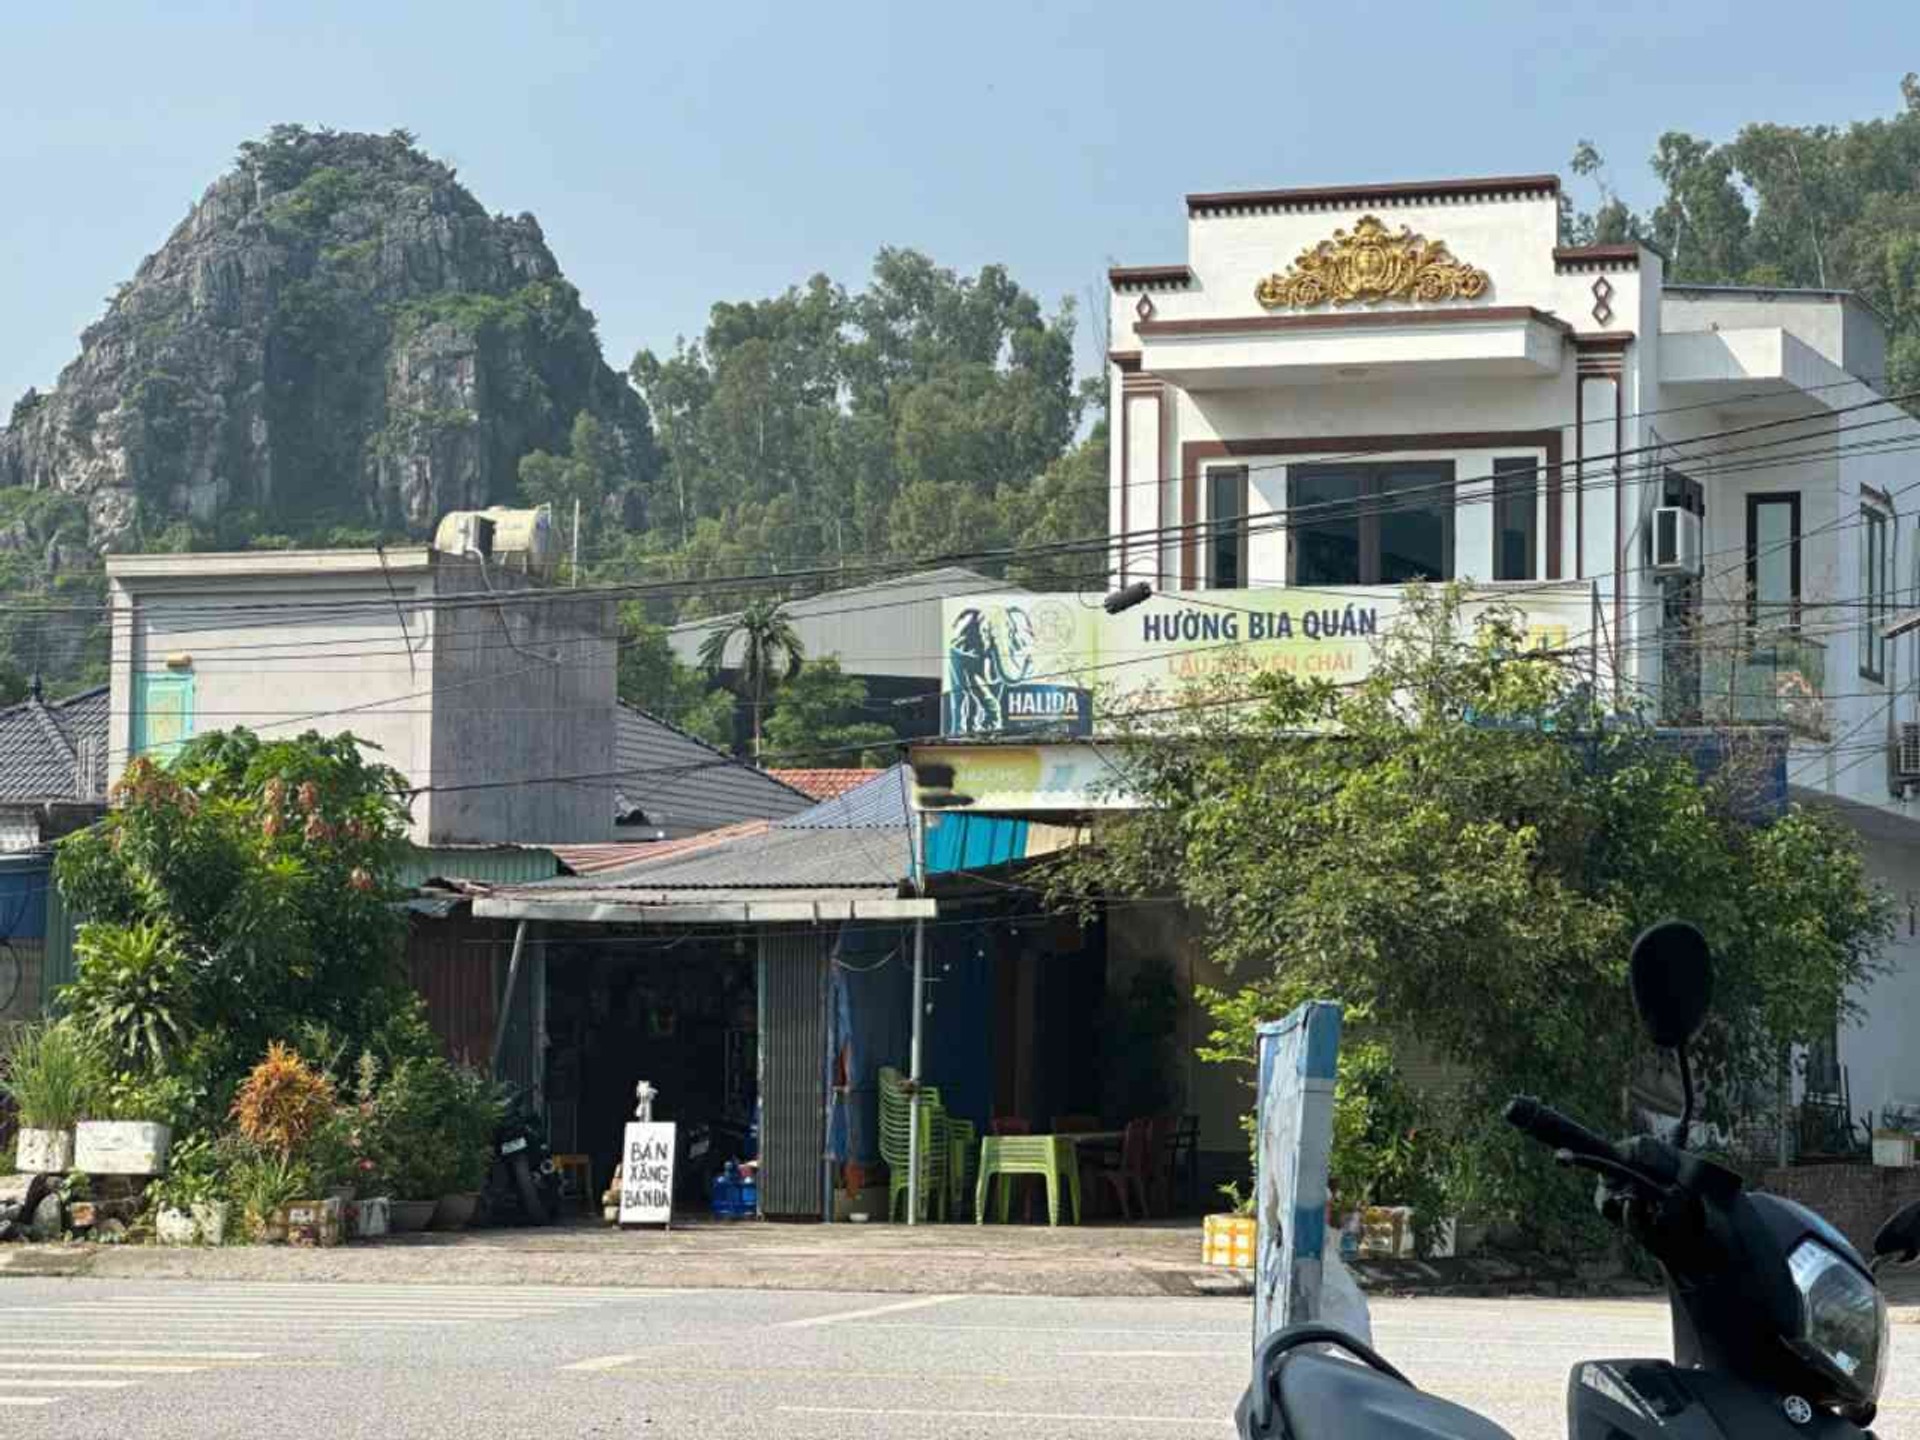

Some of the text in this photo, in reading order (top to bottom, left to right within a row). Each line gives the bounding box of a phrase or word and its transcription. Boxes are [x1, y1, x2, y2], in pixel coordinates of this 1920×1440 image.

[1143, 603, 1378, 642] HƯỜNG BIA QUÁN
[1008, 691, 1079, 714] HALIDA
[630, 1136, 669, 1163] BÁN
[628, 1163, 672, 1184] XĂNG
